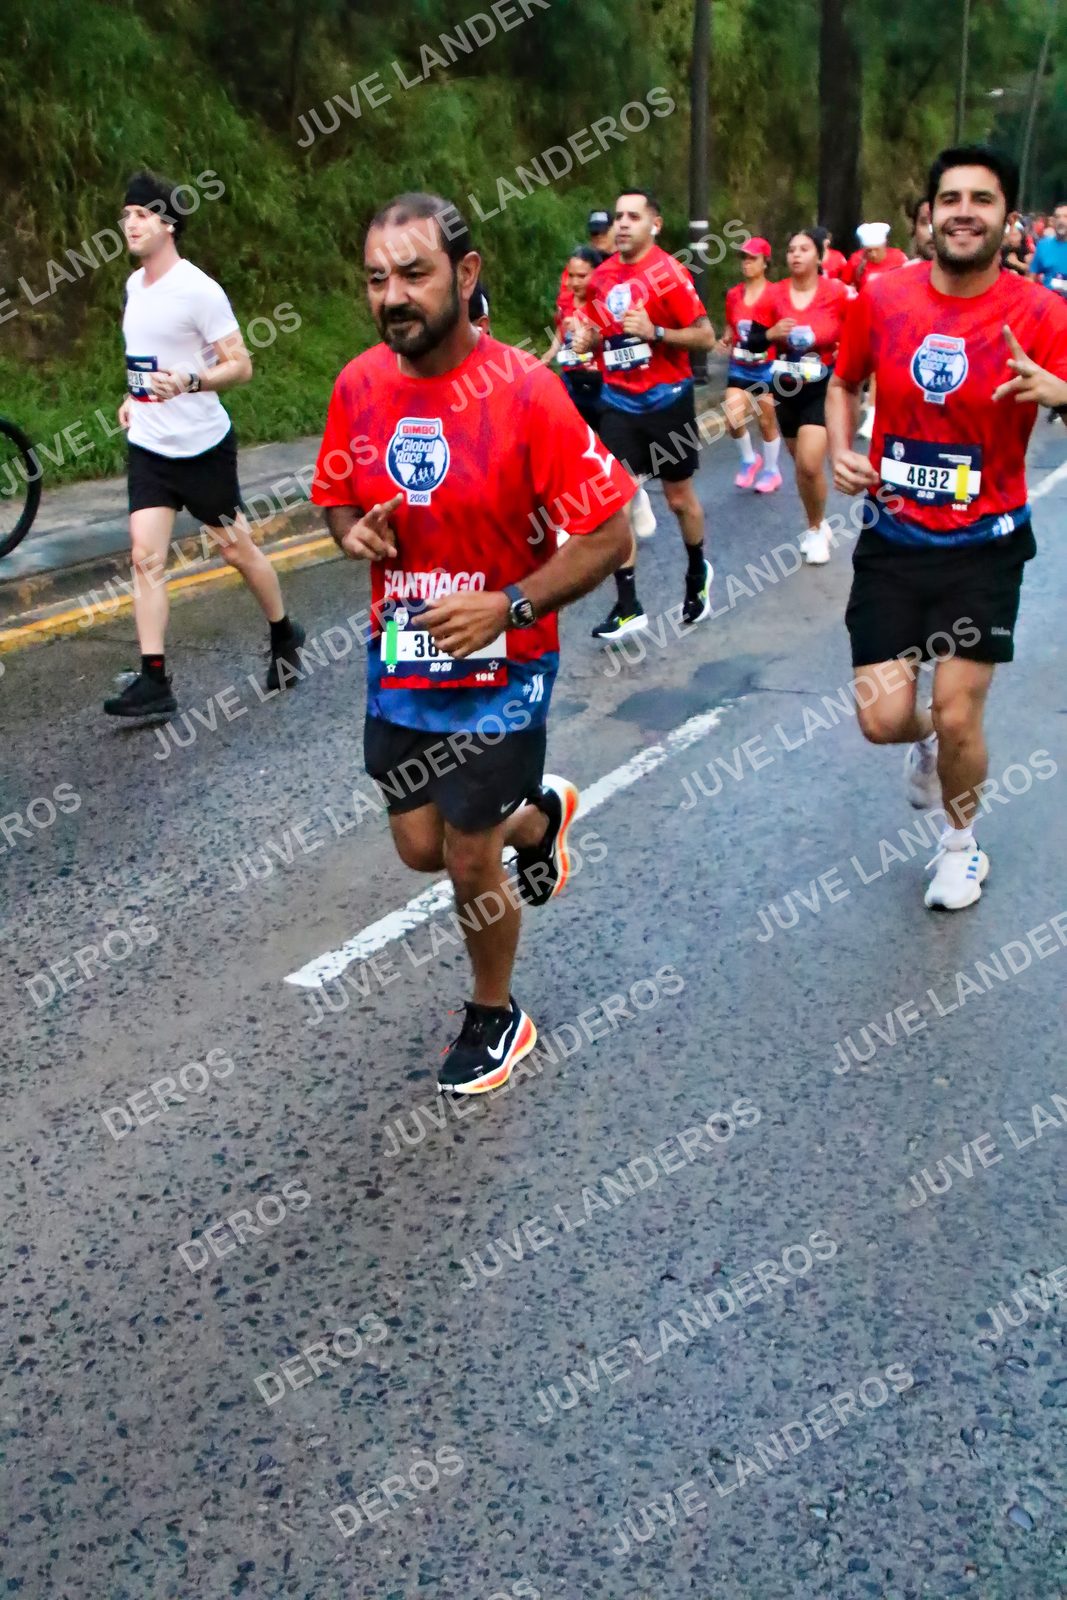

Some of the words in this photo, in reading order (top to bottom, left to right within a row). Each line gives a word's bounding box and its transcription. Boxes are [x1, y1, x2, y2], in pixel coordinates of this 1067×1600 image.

[402, 426, 436, 434] BIMBO
[402, 439, 435, 453] Global
[396, 451, 423, 463] Race
[906, 466, 951, 489] 4832
[410, 494, 428, 502] 2026
[384, 569, 486, 599] SANTIAGO
[475, 672, 495, 682] 10K
